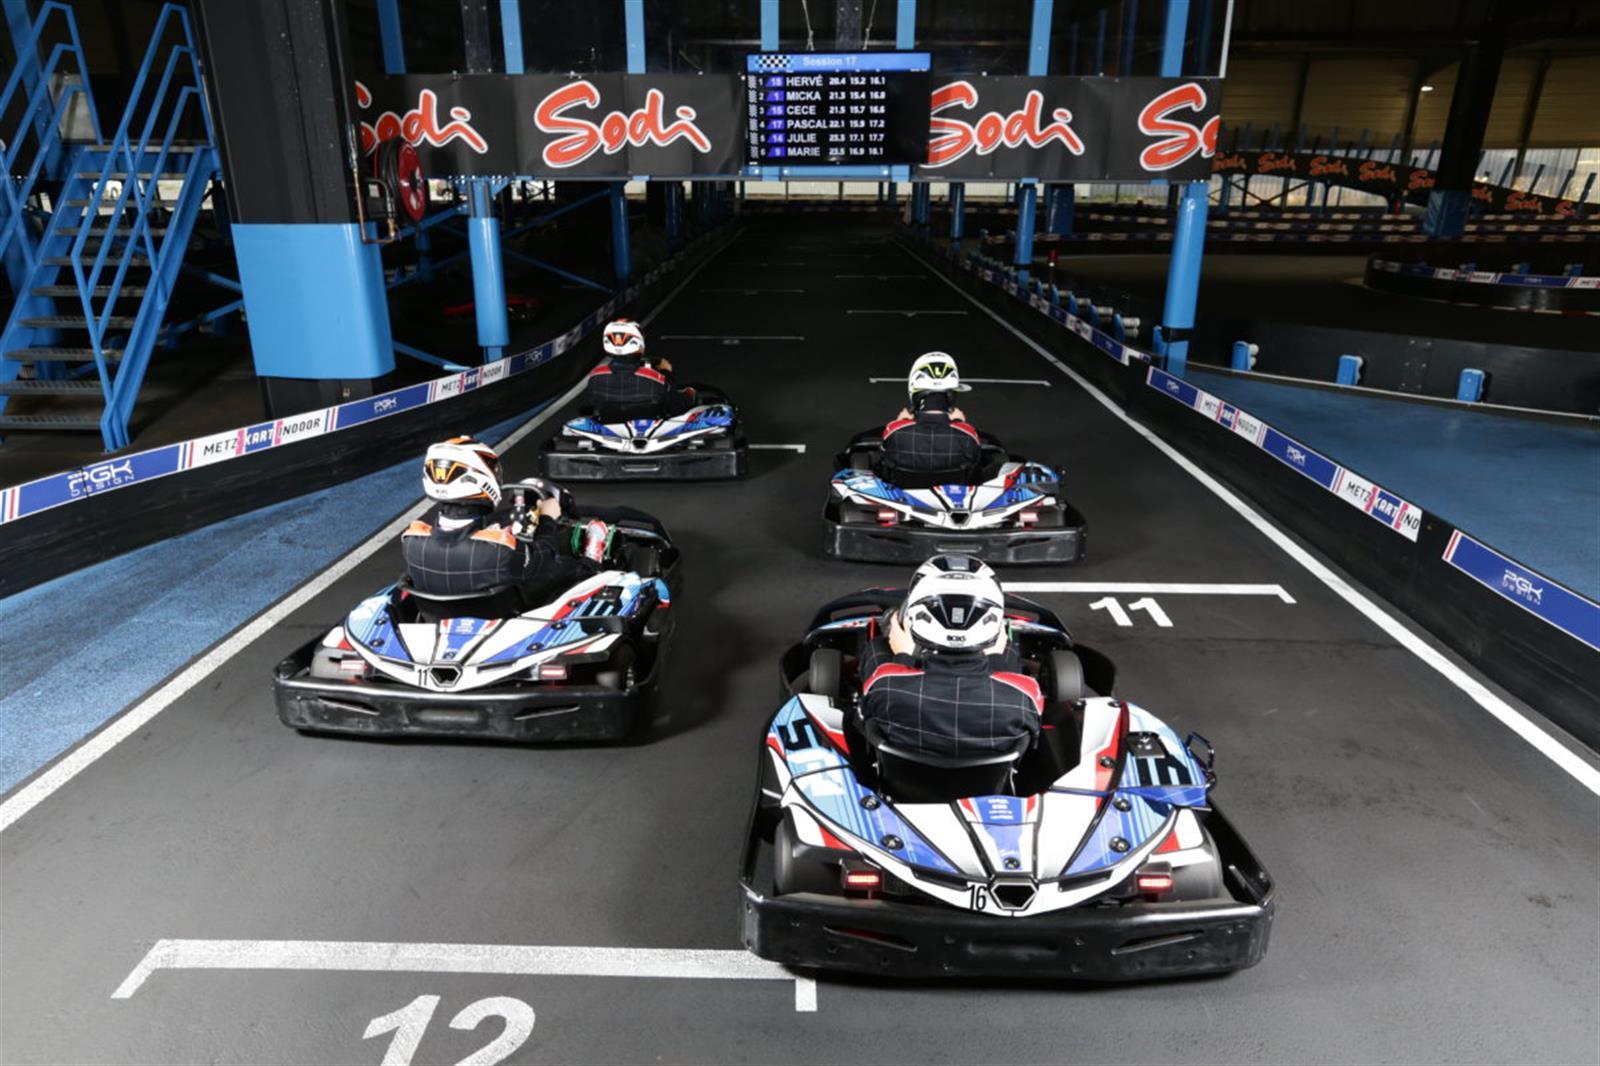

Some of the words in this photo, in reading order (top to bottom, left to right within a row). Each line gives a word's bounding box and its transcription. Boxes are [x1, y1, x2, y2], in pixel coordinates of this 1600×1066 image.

[803, 57, 841, 67] Session
[845, 56, 857, 67] 17
[786, 74, 823, 87] HERVÉ
[786, 91, 822, 102] MICKA
[786, 105, 817, 116] CECE
[534, 80, 711, 168] Sodi
[786, 119, 828, 130] PASCAL
[919, 81, 1085, 169] Sodi
[786, 133, 817, 144] JULIE
[787, 147, 821, 158] MARIE
[203, 437, 239, 457] METZ
[244, 428, 274, 447] KART
[278, 416, 321, 437] INDOOR
[1345, 480, 1373, 502] METZ
[1373, 496, 1400, 519] KART
[1087, 595, 1175, 628] 11
[417, 667, 429, 688] 11
[966, 882, 988, 912] 16
[361, 993, 537, 1066] 12
